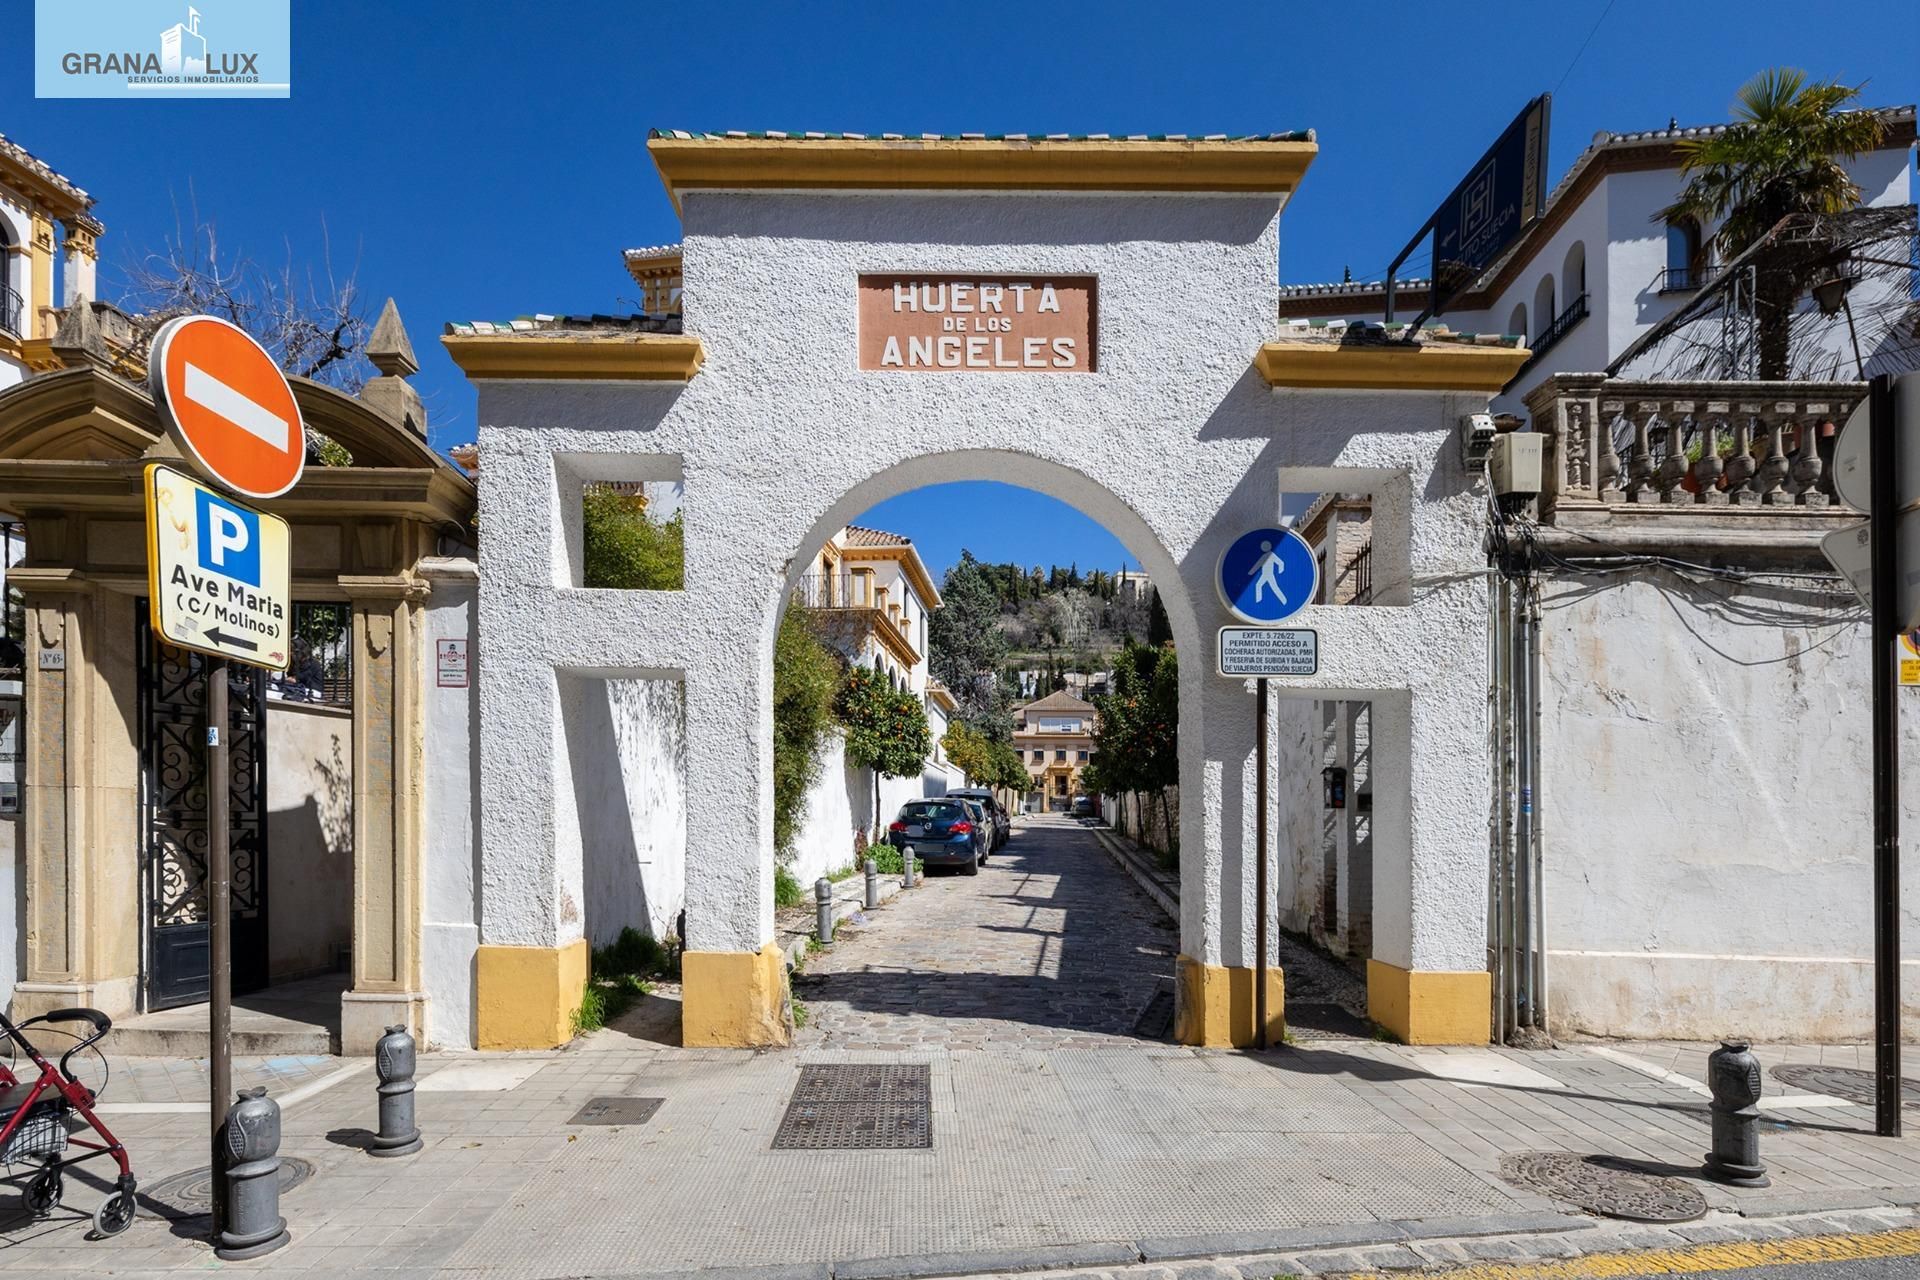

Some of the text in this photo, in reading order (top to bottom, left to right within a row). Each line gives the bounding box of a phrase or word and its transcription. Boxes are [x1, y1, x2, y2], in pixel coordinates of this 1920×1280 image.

[1482, 203, 1516, 245] SUECIA
[893, 281, 1060, 313] HUERTA
[943, 317, 1012, 332] DE LOS
[880, 335, 1077, 369] ANGELES
[208, 502, 249, 567] P
[171, 564, 283, 619] Ave Maria
[1242, 632, 1265, 640] EXPTE.
[1229, 640, 1271, 648] PERMITIDO
[1272, 640, 1301, 648] ACCESO
[1224, 648, 1255, 656] COCHERAS
[1230, 656, 1255, 664] RESERVA
[1291, 657, 1313, 665] BAJADA
[1224, 664, 1313, 673] DE VIAJEROS PENSIÓN SUECIA
